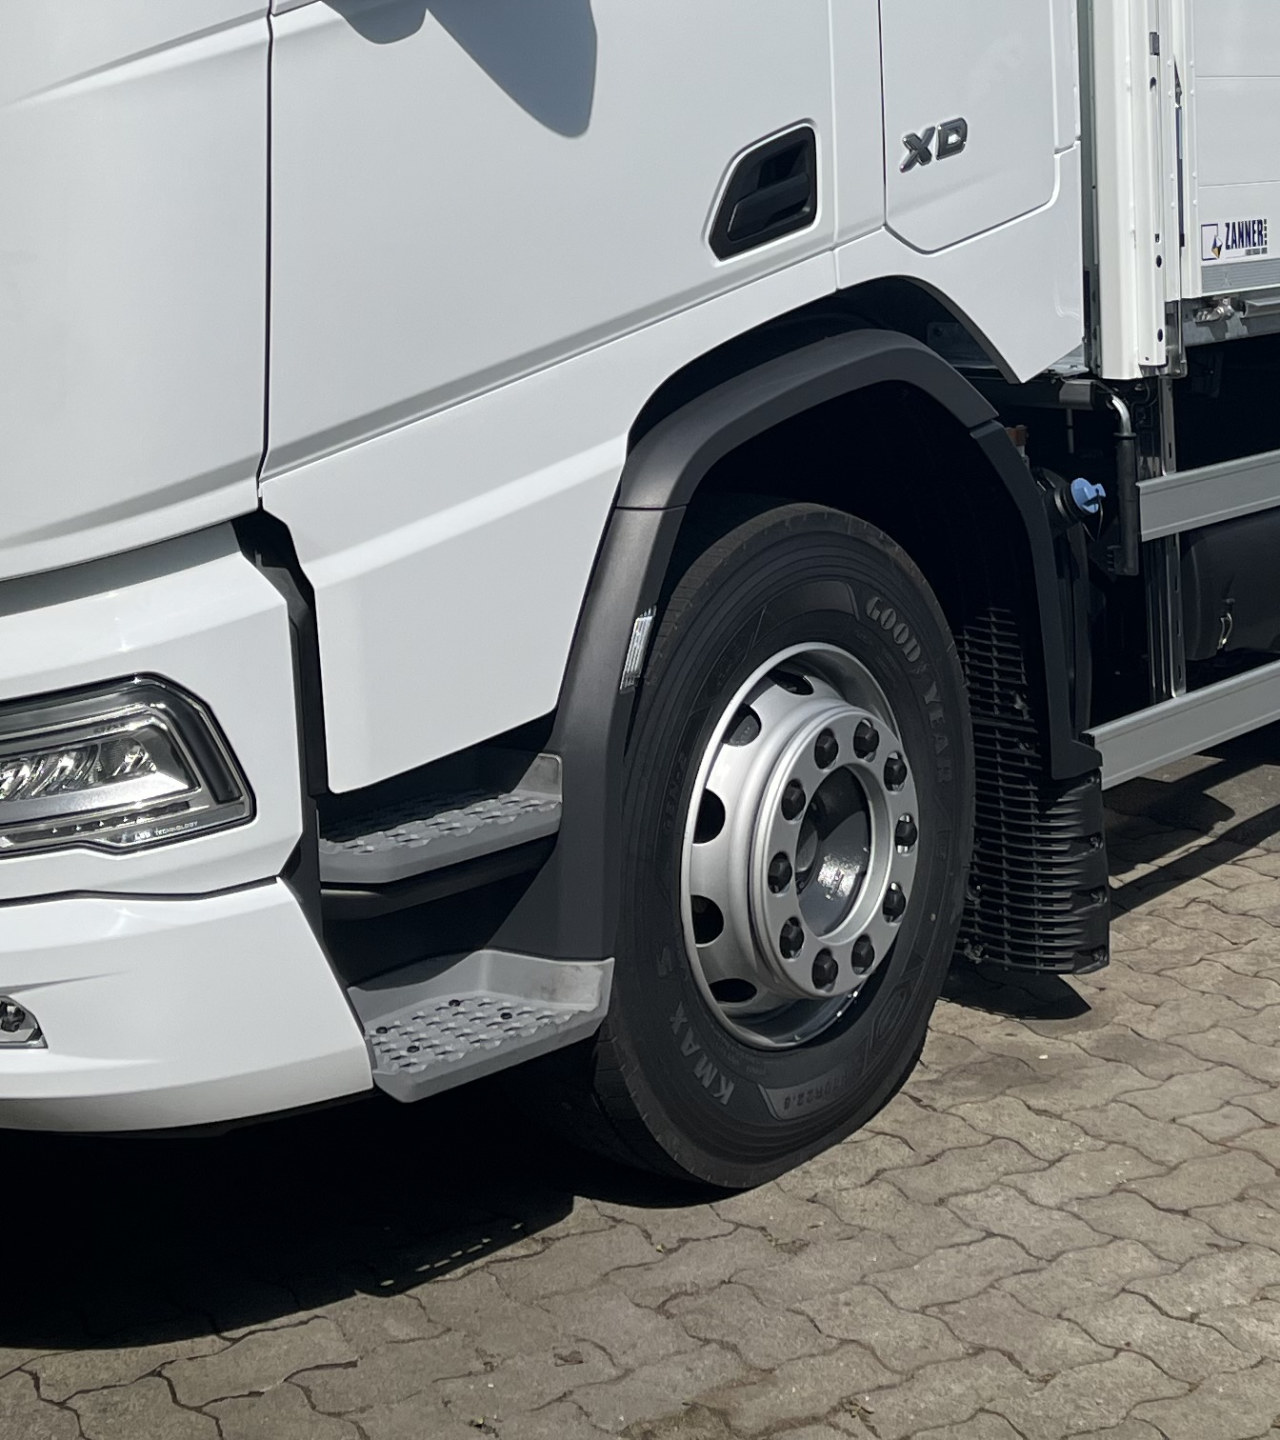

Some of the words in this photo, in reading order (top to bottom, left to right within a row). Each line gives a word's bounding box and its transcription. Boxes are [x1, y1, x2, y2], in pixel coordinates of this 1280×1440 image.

[899, 116, 968, 174] XD
[1224, 218, 1264, 251] ZANNER
[668, 1001, 735, 1106] KMAX
